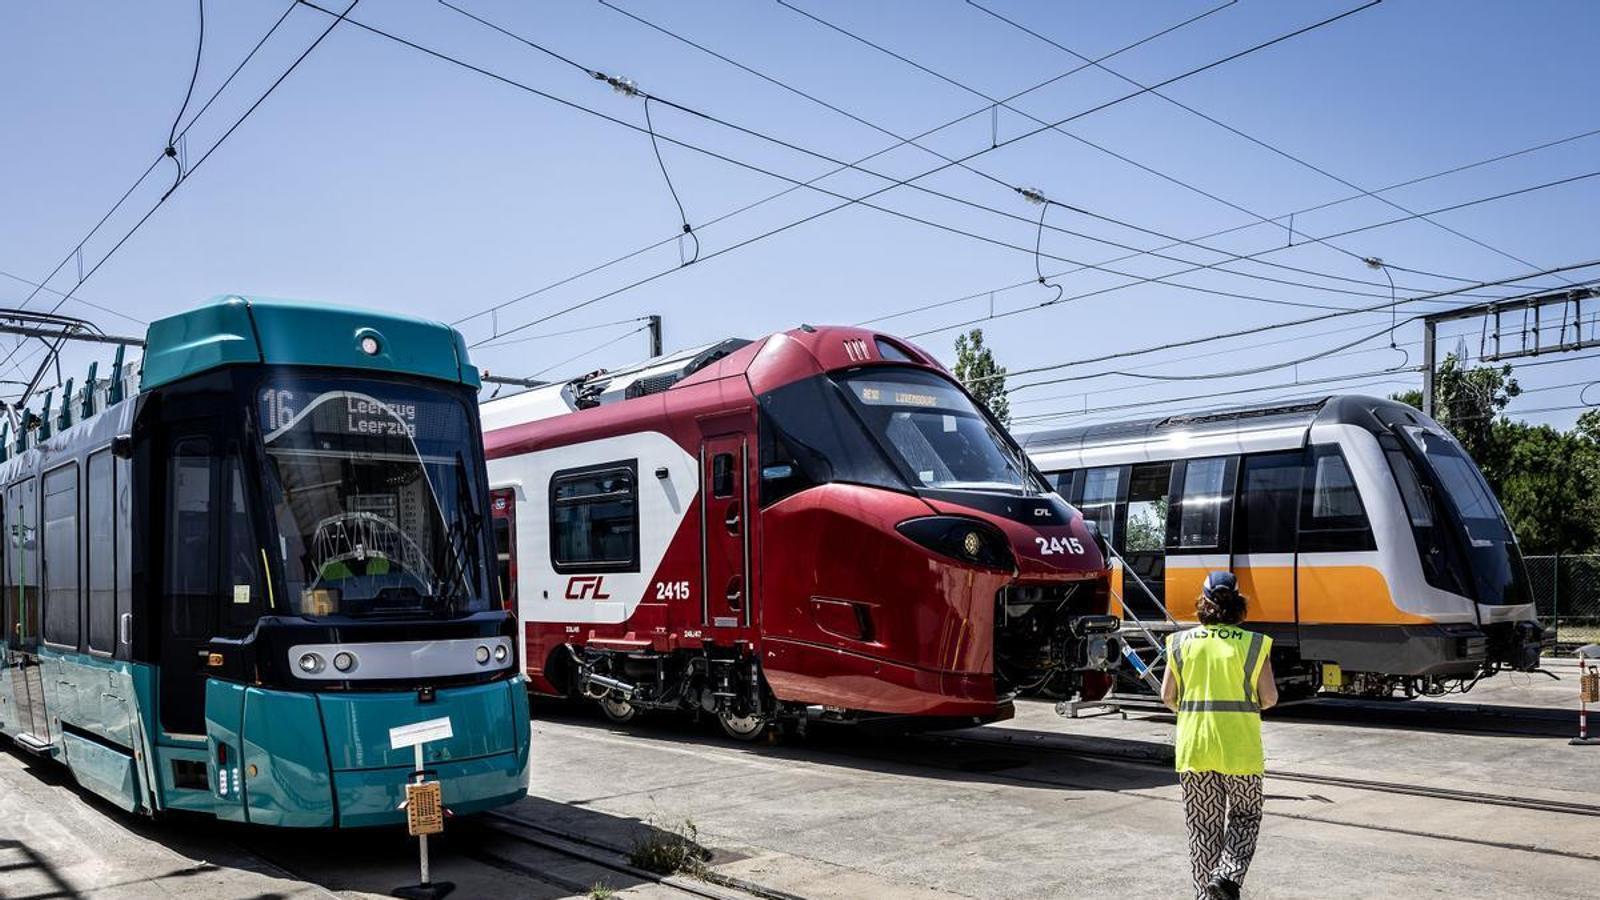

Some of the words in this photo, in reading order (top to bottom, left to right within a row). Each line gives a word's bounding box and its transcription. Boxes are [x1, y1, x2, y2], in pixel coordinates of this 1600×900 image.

[263, 388, 293, 429] 16
[347, 398, 415, 420] Leerzug
[348, 414, 416, 438] Leerzug
[1034, 508, 1052, 517] CFL
[1035, 536, 1085, 555] 2415
[565, 575, 610, 600] CFL
[656, 581, 689, 600] 2415
[1184, 628, 1243, 641] ALSTOM
